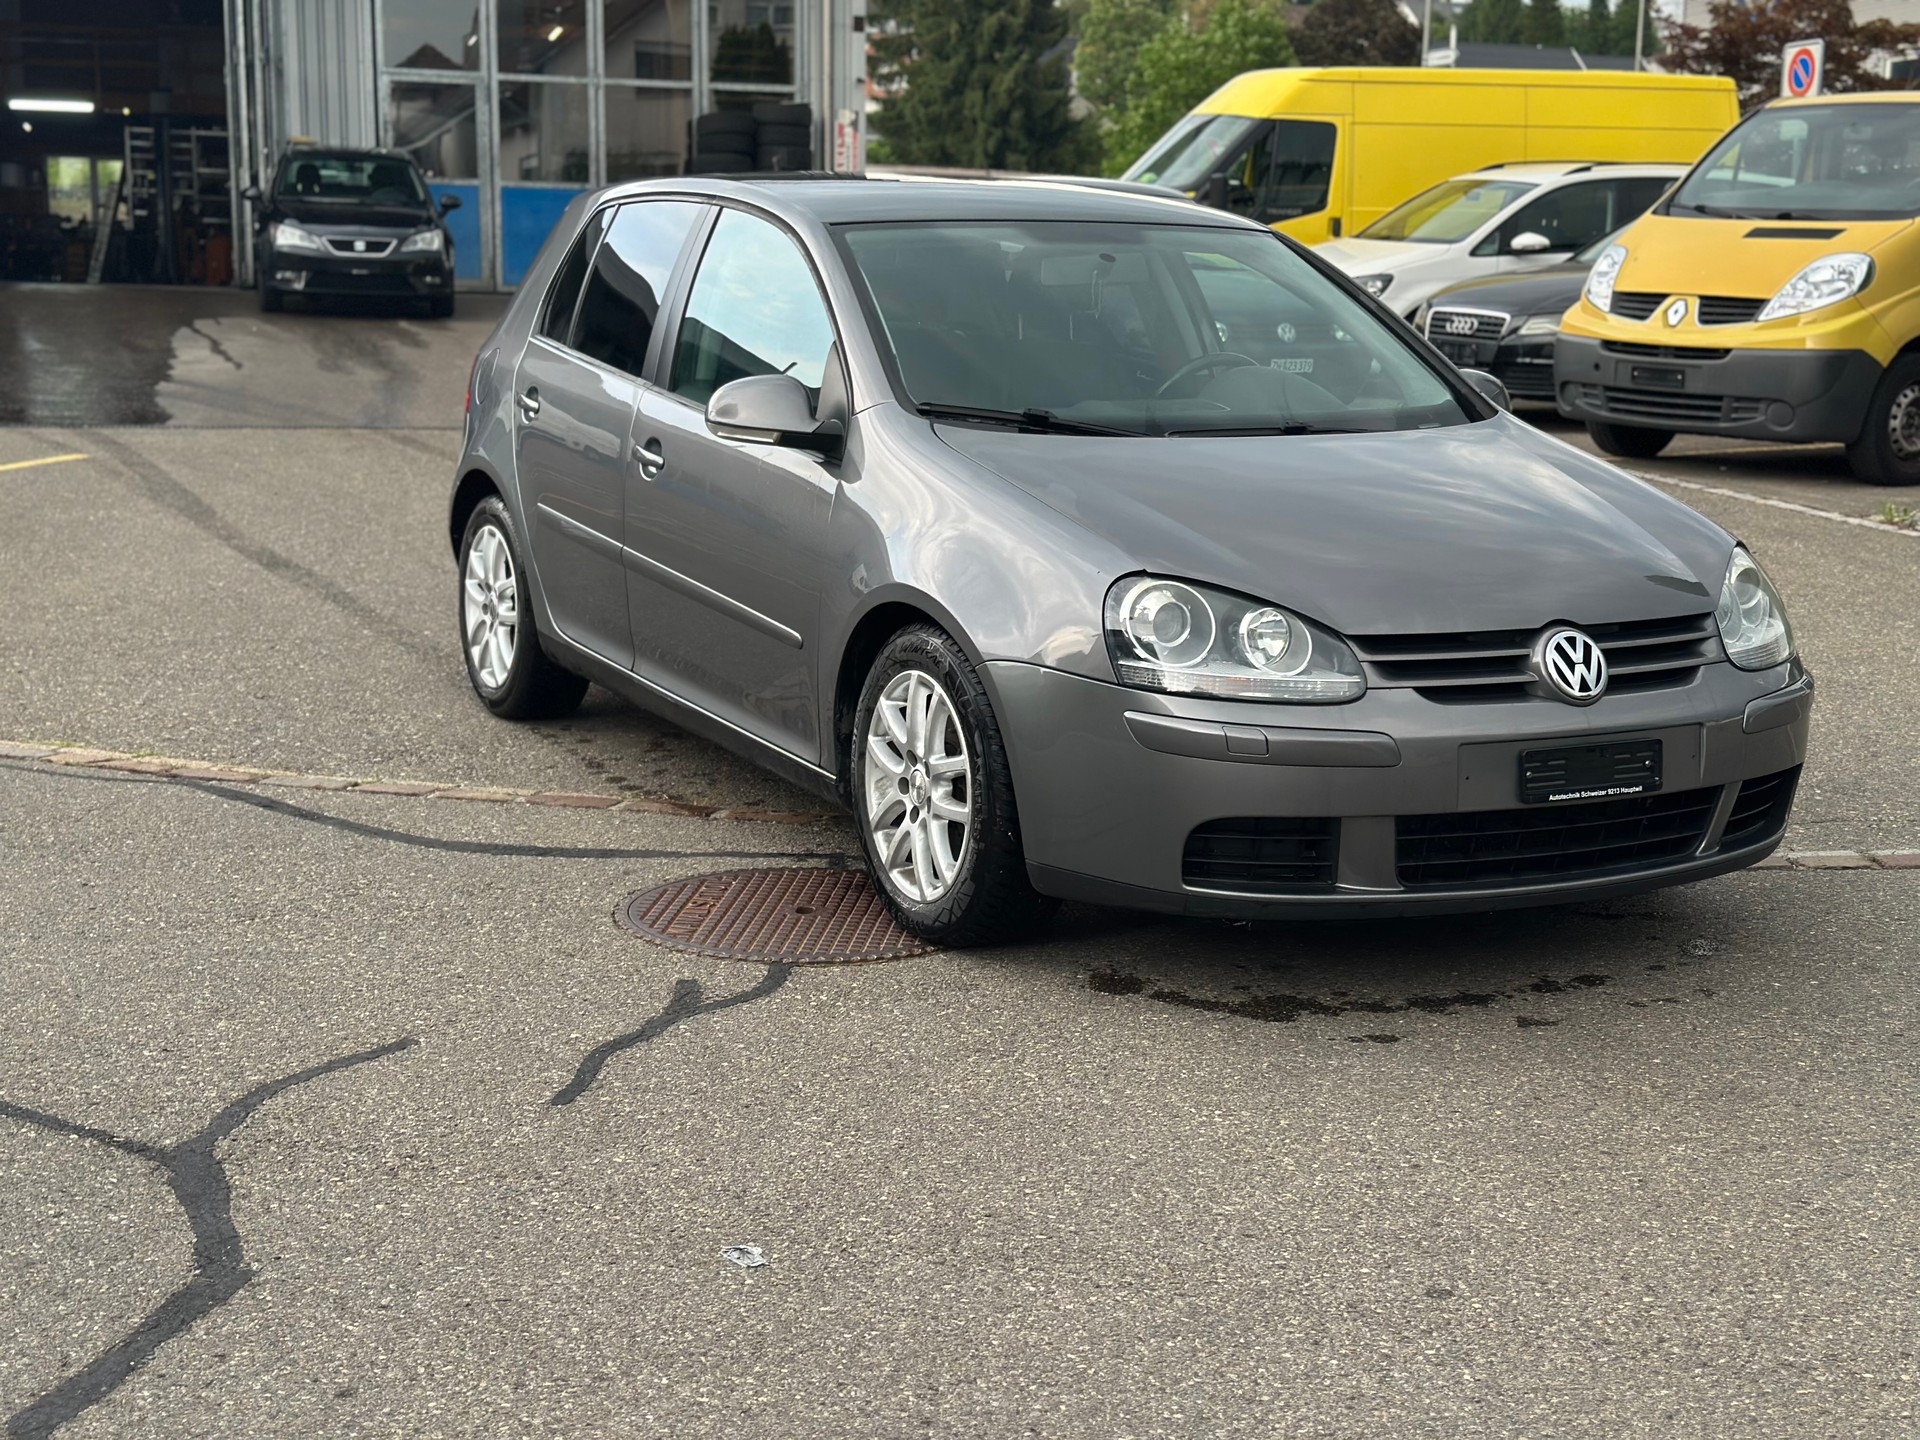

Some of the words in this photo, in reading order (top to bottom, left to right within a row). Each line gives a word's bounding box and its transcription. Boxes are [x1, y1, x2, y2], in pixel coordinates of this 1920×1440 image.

[1546, 631, 1608, 698] VW
[1549, 792, 1580, 801] Autotechnik
[1581, 790, 1607, 798] Schweizer
[1607, 787, 1620, 795] 9213
[1620, 785, 1642, 794] Hauptwil
